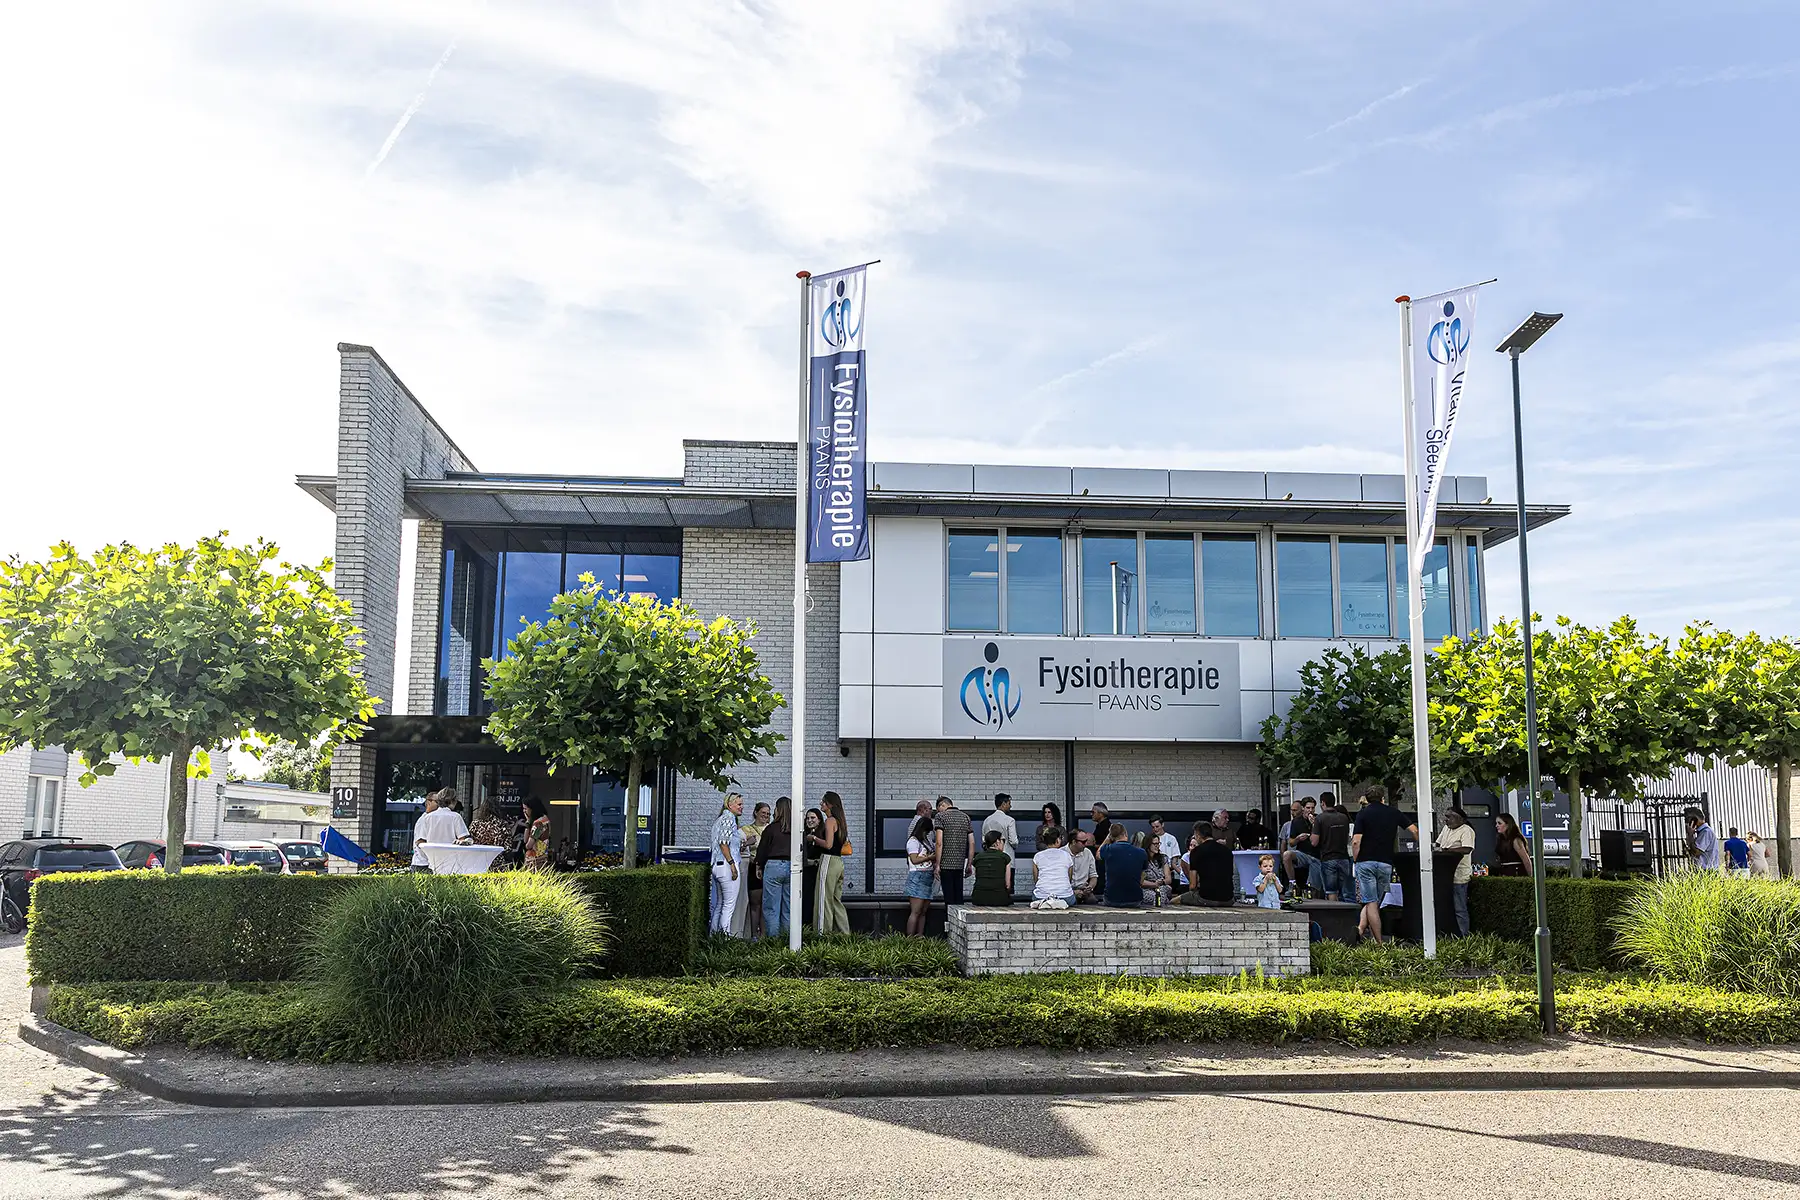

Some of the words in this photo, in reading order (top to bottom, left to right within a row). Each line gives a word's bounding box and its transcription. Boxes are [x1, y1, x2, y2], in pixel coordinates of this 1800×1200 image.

[815, 426, 831, 490] PAANS
[825, 363, 862, 548] Fysiotherapie
[1038, 656, 1220, 695] Fysiotherapie
[1098, 694, 1162, 711] PAANS
[336, 788, 354, 801] 10
